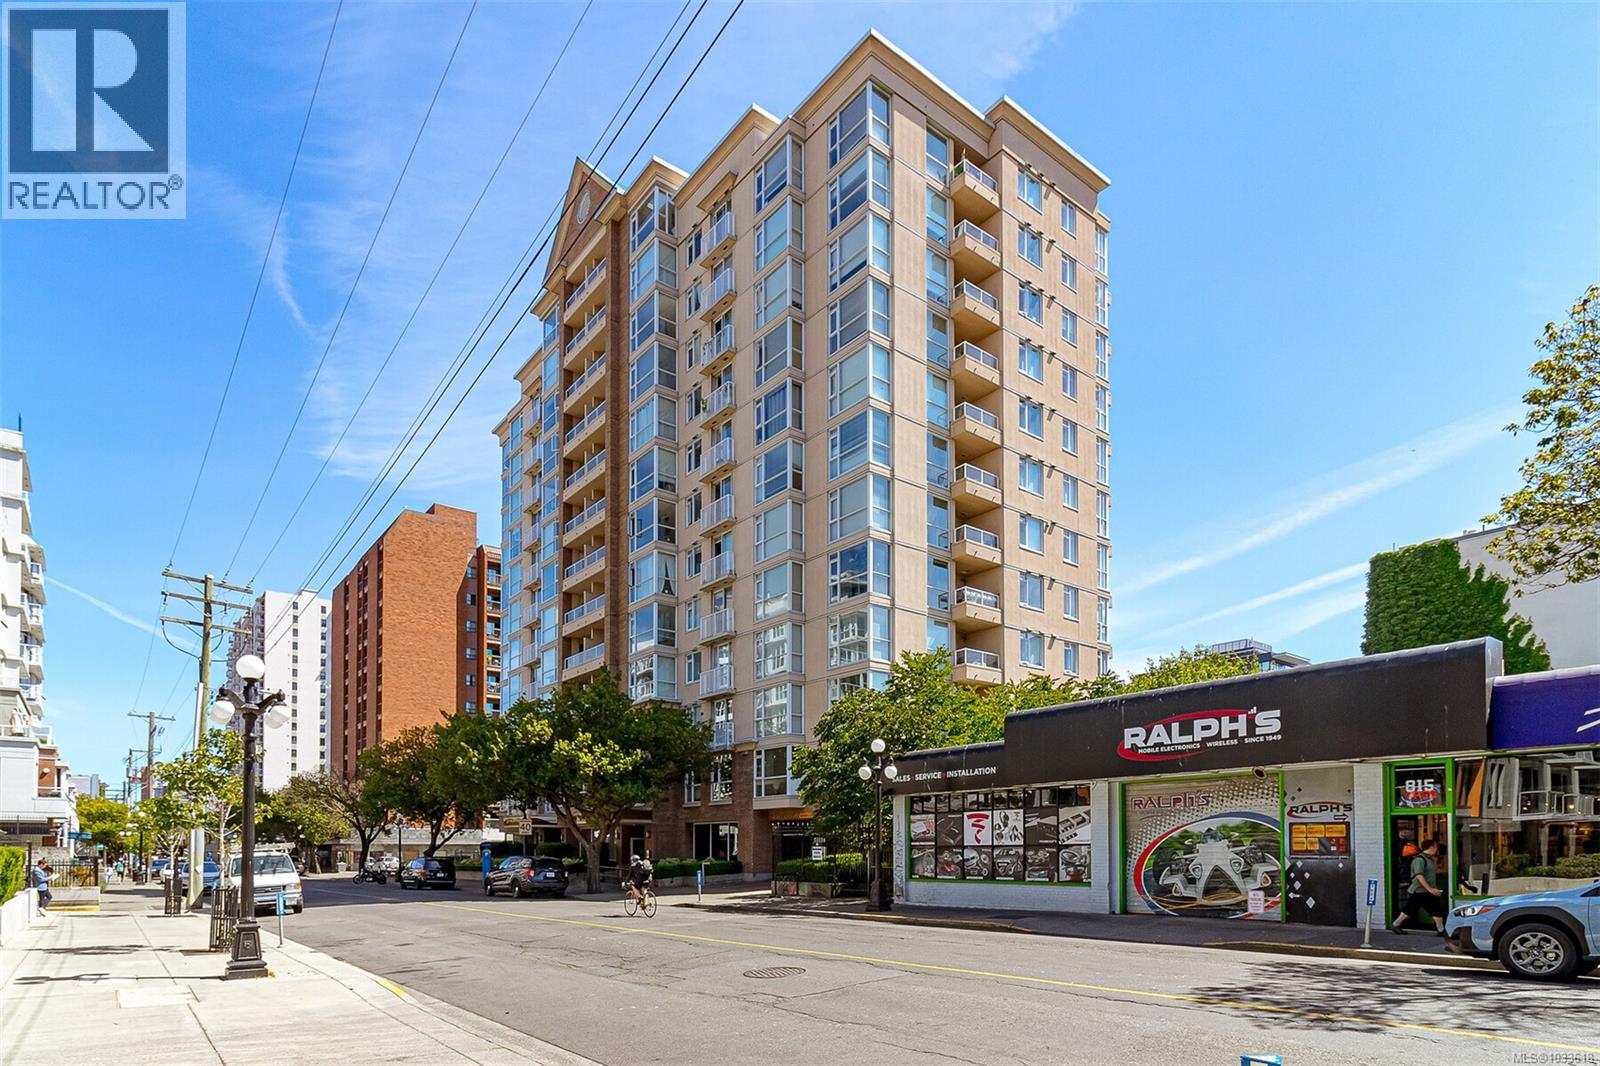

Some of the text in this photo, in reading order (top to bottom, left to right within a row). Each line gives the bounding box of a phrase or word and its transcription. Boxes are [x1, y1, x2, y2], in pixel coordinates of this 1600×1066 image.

[1138, 733, 1282, 754] MOBILE ELECTRONICS WIRELESS SINCE 1949
[915, 771, 941, 781] SERVICE
[946, 766, 997, 778] INSTALLATION
[1405, 779, 1434, 792] 815
[520, 823, 531, 831] 40
